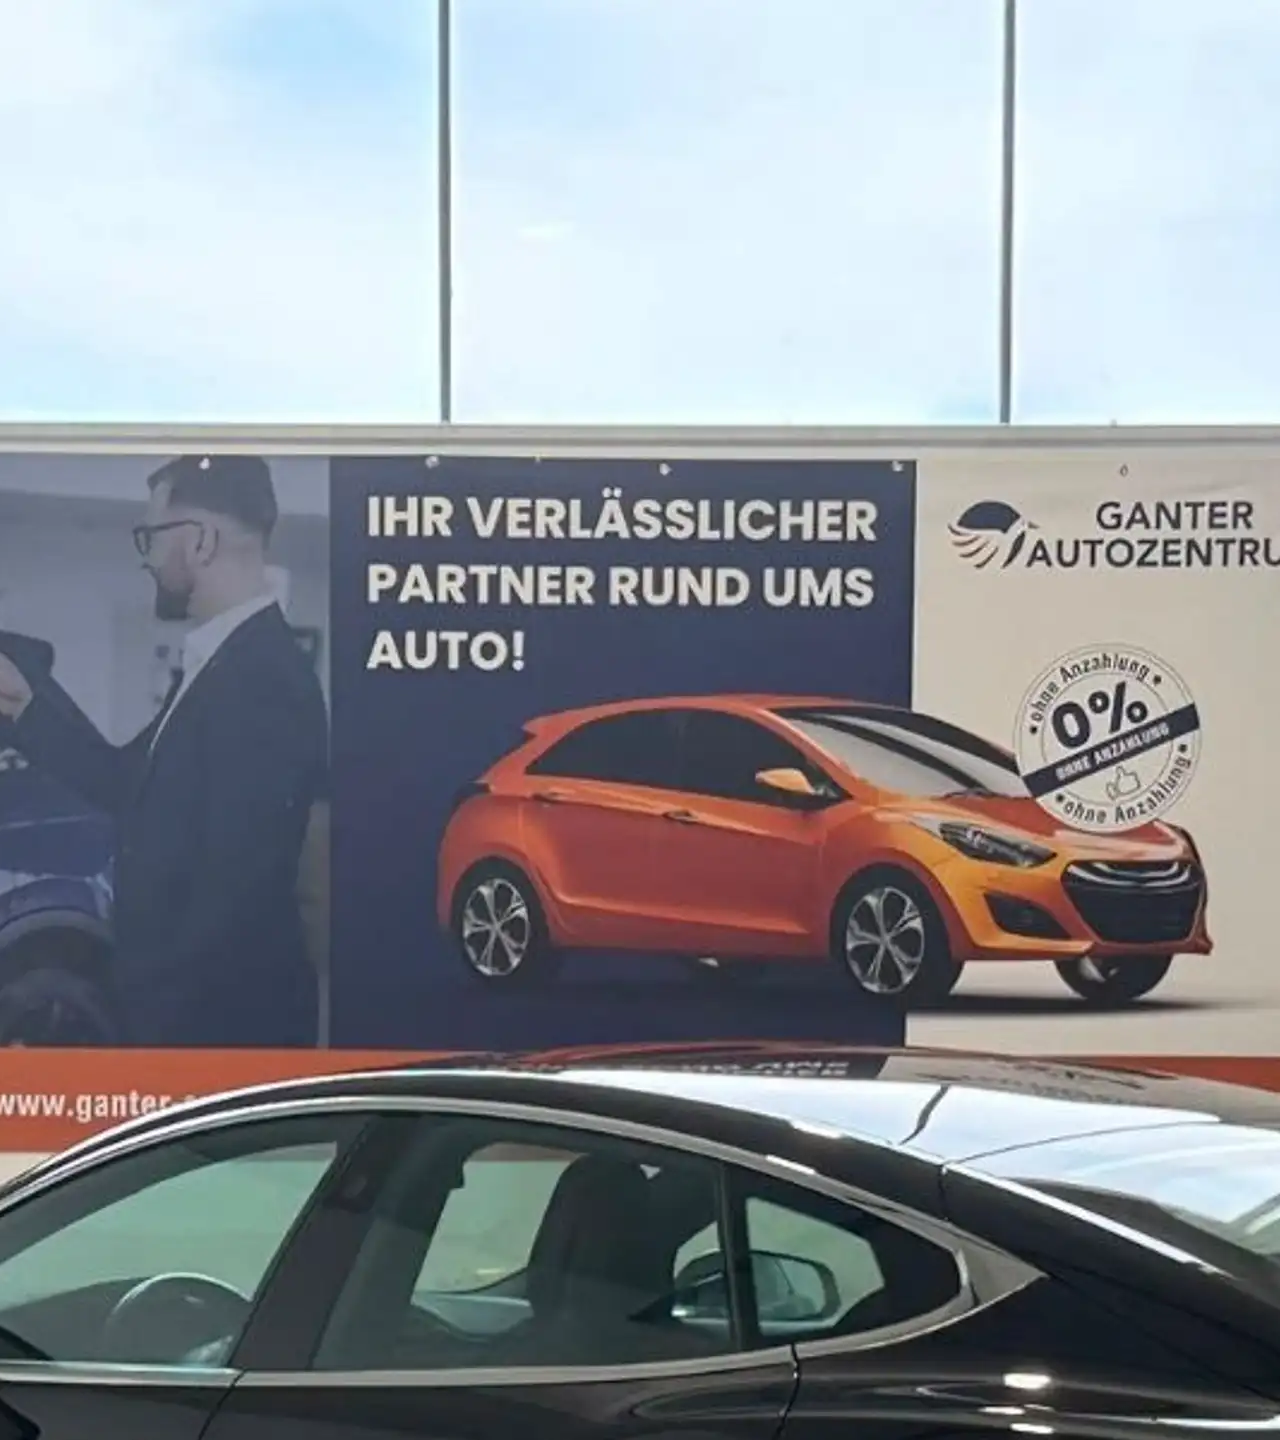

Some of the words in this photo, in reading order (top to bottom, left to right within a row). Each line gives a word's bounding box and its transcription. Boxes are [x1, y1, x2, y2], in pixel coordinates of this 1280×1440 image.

[366, 496, 454, 538] IHR
[466, 487, 877, 542] VERLÄSSLICHER
[1095, 500, 1254, 531] GANTER
[366, 563, 595, 606] PARTNER
[609, 566, 750, 607] RUND
[763, 567, 874, 608] UMS
[365, 630, 526, 672] AUTO!
[1029, 681, 1061, 723] ohne
[1059, 652, 1151, 683] Anzahlung
[1051, 680, 1149, 750] 0%
[1063, 798, 1107, 824] ohne
[1114, 756, 1192, 824] Anzahlung
